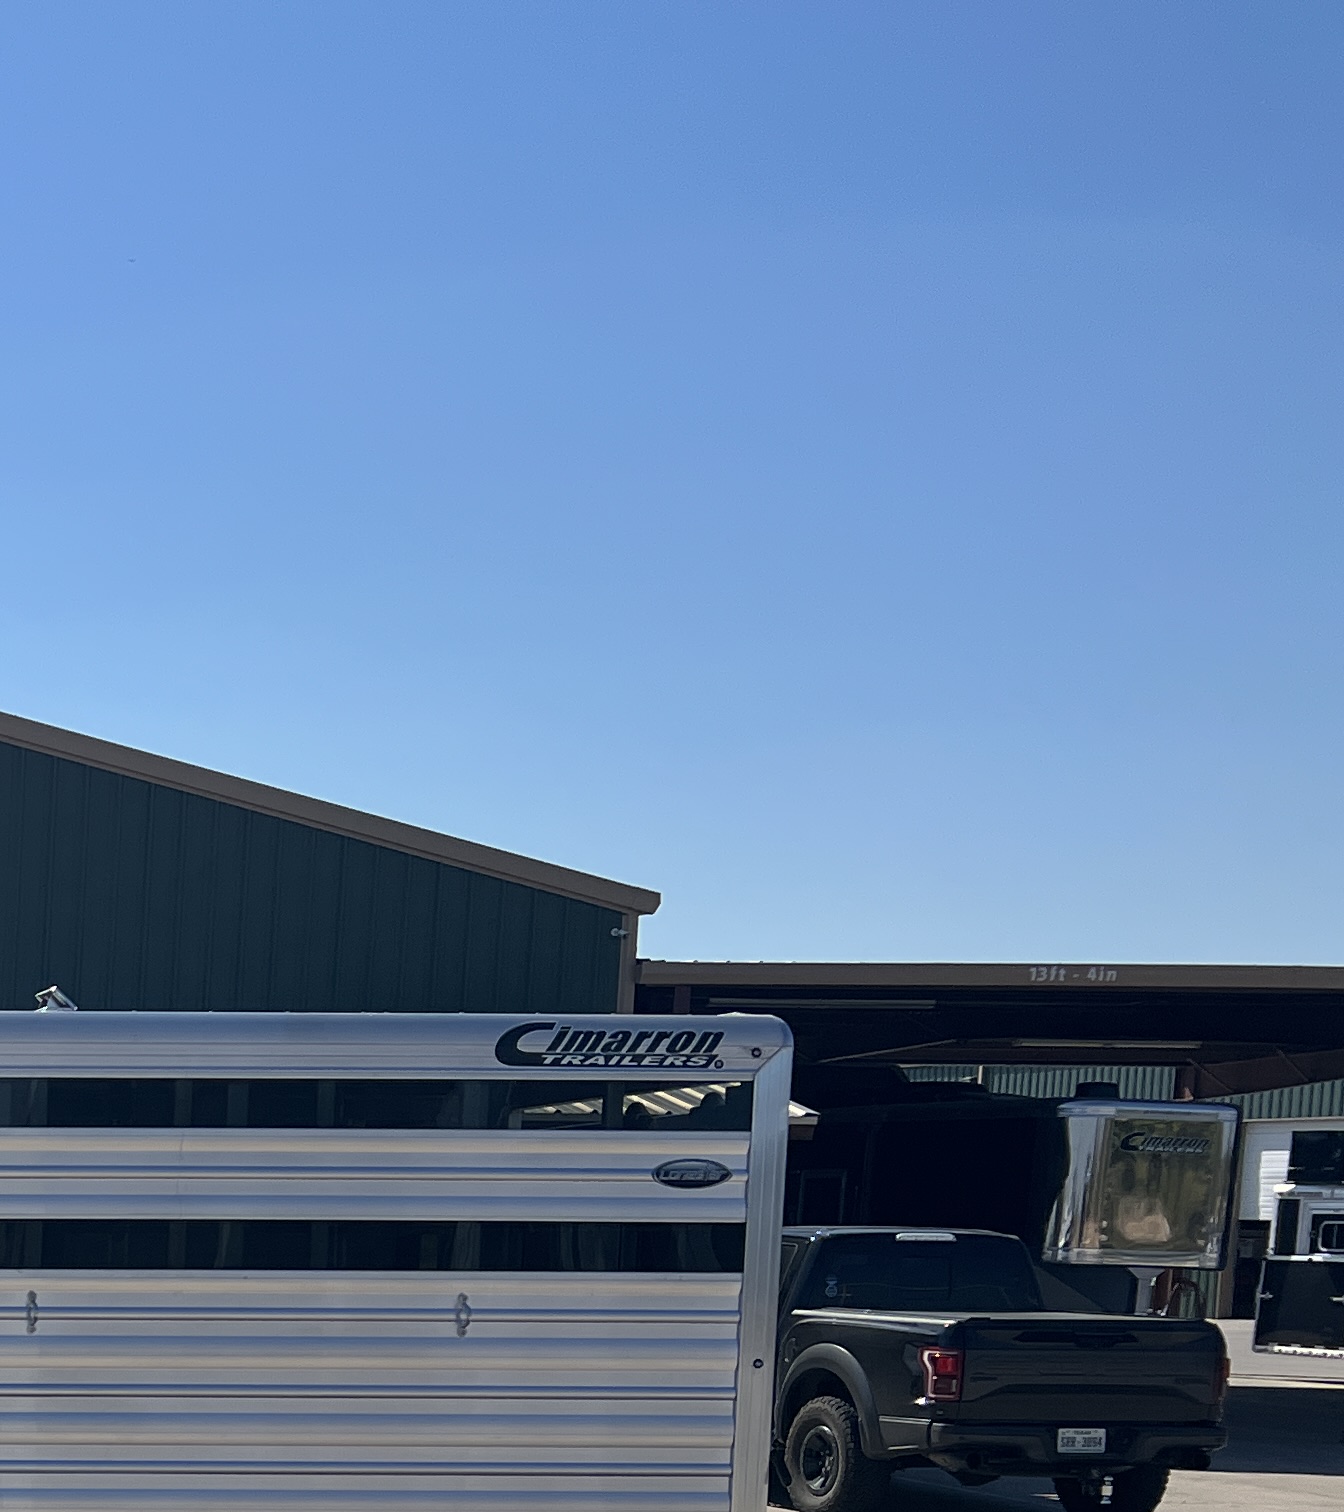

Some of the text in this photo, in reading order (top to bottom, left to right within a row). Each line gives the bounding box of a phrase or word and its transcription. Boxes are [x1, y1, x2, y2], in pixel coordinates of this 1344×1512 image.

[1029, 965, 1066, 981] 13ft
[1087, 966, 1118, 981] 4in
[495, 1021, 725, 1068] Cimarron
[539, 1054, 709, 1067] TRAILERS
